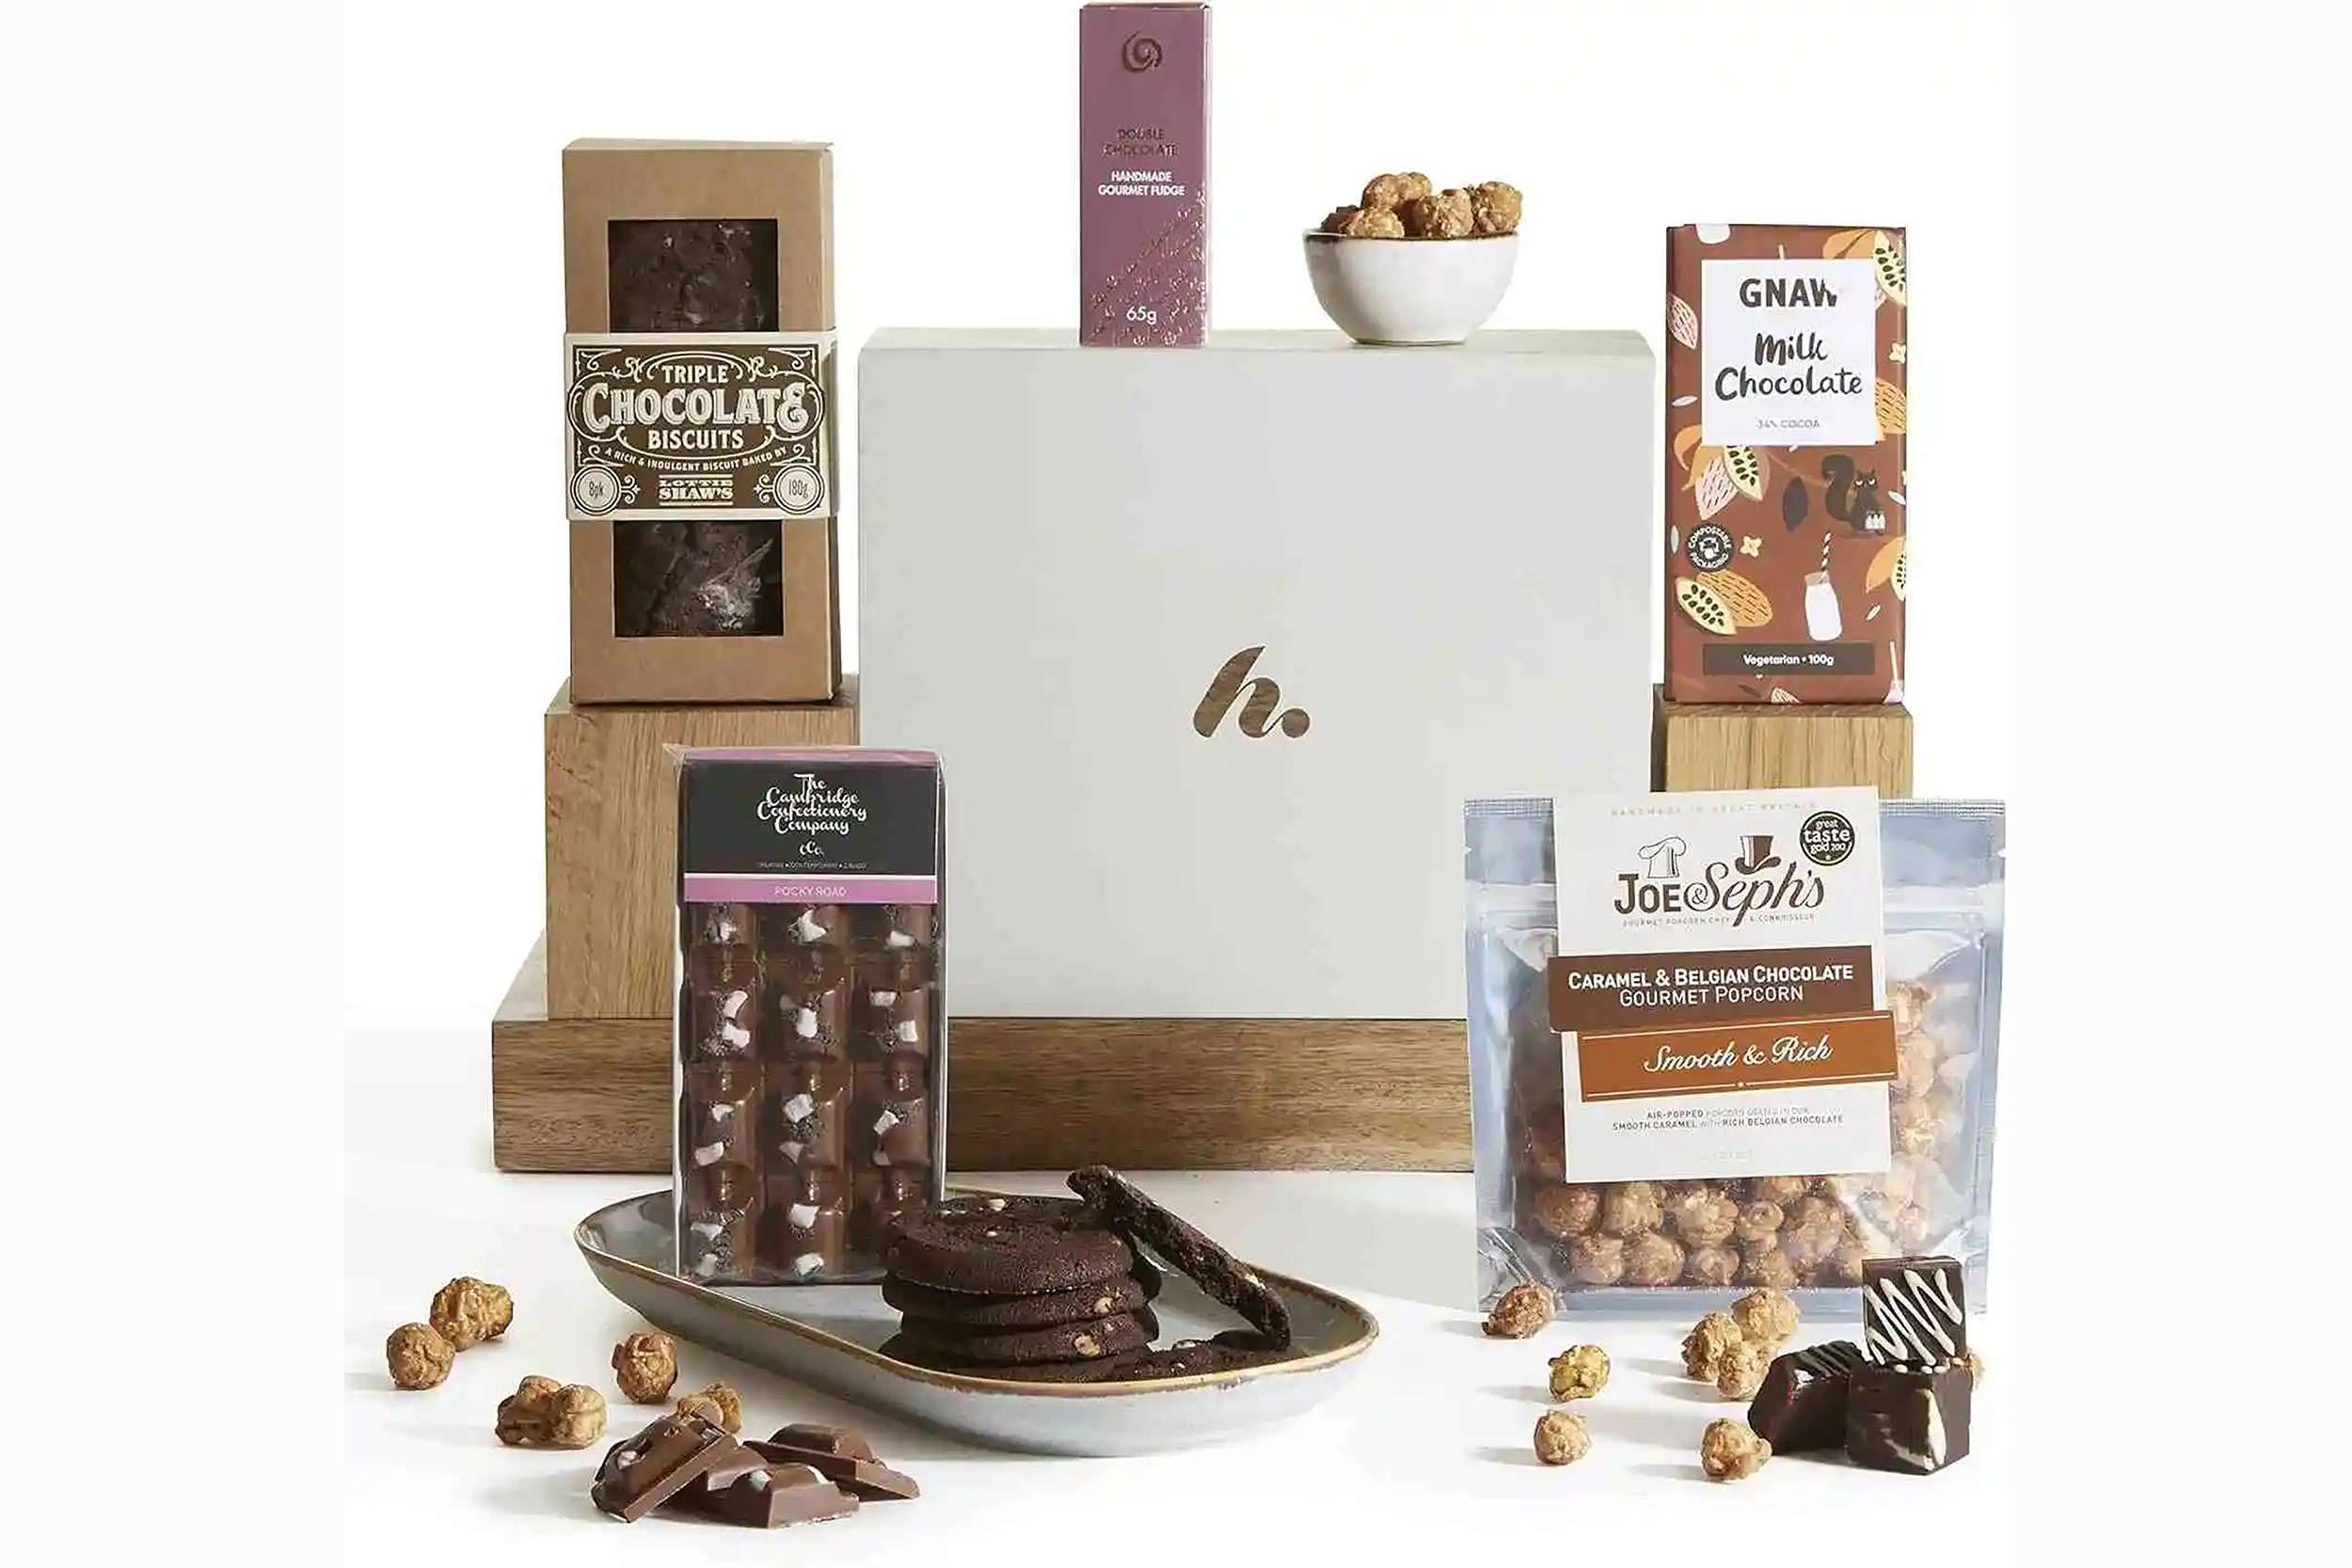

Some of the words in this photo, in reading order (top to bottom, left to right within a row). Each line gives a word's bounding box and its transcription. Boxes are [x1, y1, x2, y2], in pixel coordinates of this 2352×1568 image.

[1111, 170, 1173, 182] HANDMADE
[1097, 184, 1149, 196] GOURMET
[1150, 184, 1185, 196] FUDGE
[1739, 277, 1838, 308] GNAW
[1125, 307, 1157, 325] 65g
[1755, 332, 1828, 366] Milk
[661, 364, 730, 385] TRIPLE
[1714, 365, 1863, 402] Chocolate
[582, 382, 810, 434] CHOCOLATE
[1780, 419, 1820, 429] COCOA
[647, 428, 745, 451] BISCUITS
[604, 447, 612, 457] A
[613, 451, 638, 465] RICH
[647, 459, 701, 471] INDULGENT
[702, 460, 740, 471] BISCUIT
[741, 452, 773, 467] BAKED
[773, 445, 787, 458] BY
[659, 486, 733, 500] SHAW'S
[788, 478, 808, 499] 180g
[1688, 526, 1732, 549] COMPOSTABLE
[1742, 654, 1801, 666] Vegetarian
[1807, 654, 1835, 667] 100g
[792, 772, 827, 793] The
[766, 785, 860, 809] Cambridge
[756, 800, 867, 822] Confectionery
[774, 818, 850, 835] Company
[1804, 829, 1851, 844] taste
[1810, 841, 1830, 855] gold
[1613, 872, 1682, 914] JOE
[1684, 860, 1825, 927] Seph's
[1567, 969, 1652, 990] CARAMEL
[1655, 969, 1670, 986] &
[1675, 966, 1750, 986] BELGIAN
[1753, 963, 1854, 984] CHOCOLATE
[1618, 988, 1708, 1008] GOURMET
[1715, 985, 1804, 1005] POPCORN
[1644, 1039, 1740, 1072] Smooth
[1742, 1044, 1767, 1066] &
[1772, 1035, 1835, 1065] Rich
[1612, 1121, 1650, 1131] SMOOTH
[1653, 1119, 1698, 1130] CARAMEL
[1722, 1118, 1745, 1127] RICH
[1788, 1115, 1845, 1125] CHOCOLATE
[1646, 1109, 1704, 1119] AIR-POPPED
